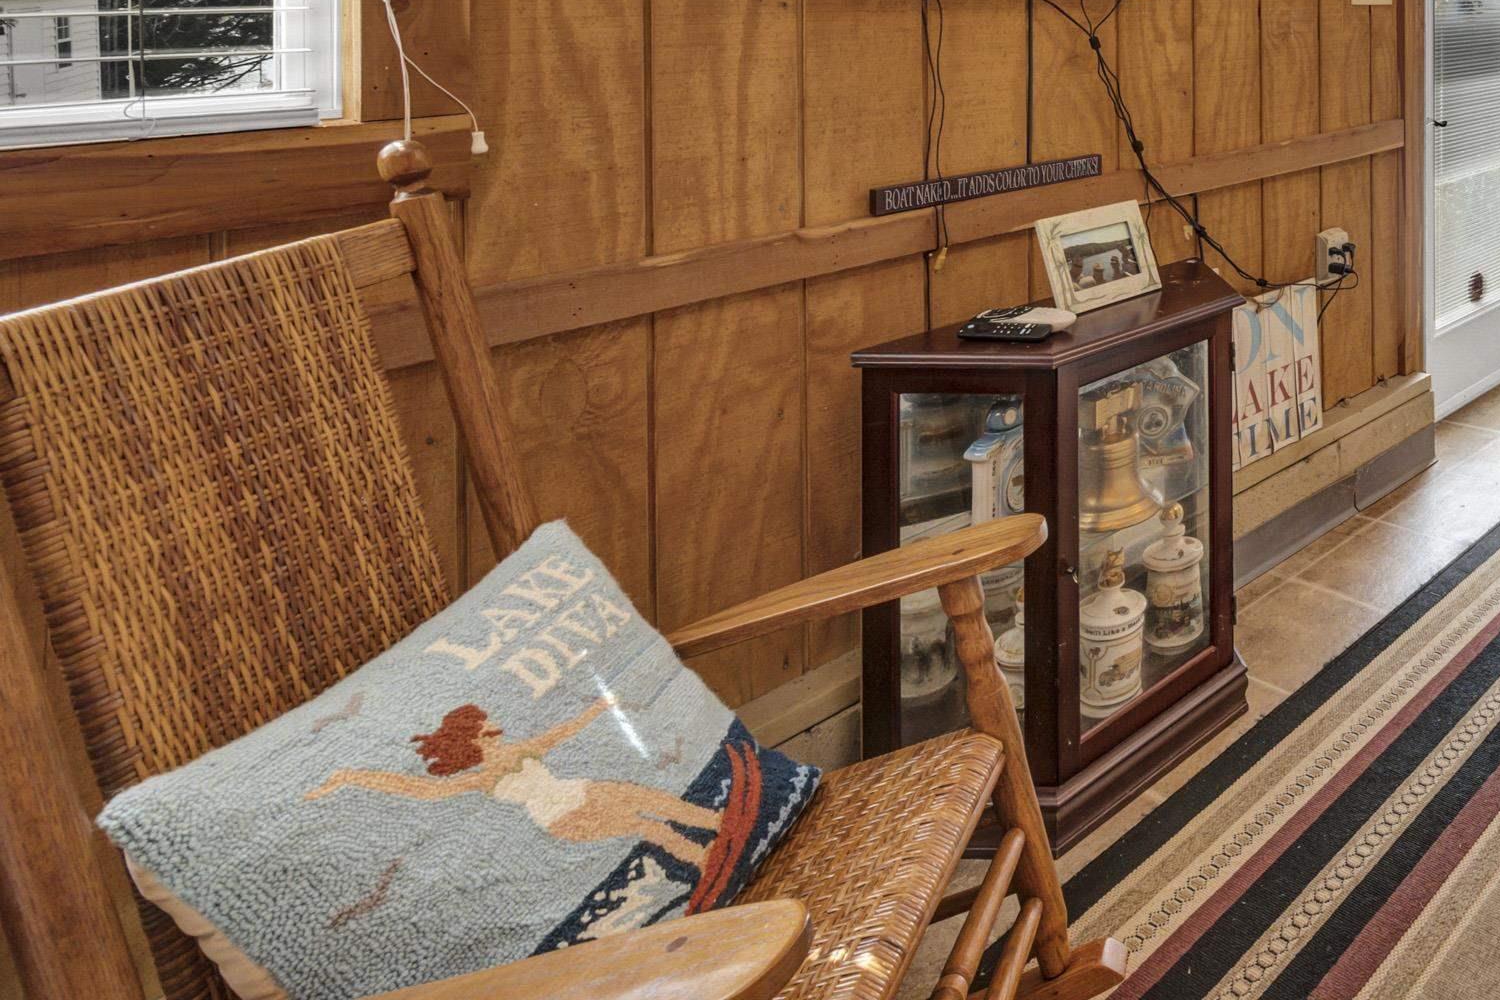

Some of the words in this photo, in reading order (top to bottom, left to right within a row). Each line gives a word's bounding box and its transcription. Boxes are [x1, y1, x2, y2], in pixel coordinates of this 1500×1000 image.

[884, 186, 914, 211] BOAT
[968, 173, 995, 196] ADDS
[996, 168, 1026, 191] COLOR
[1027, 166, 1040, 186] TO
[1041, 162, 1065, 184] YOUR
[1232, 354, 1315, 424] AKE
[425, 555, 594, 671] LAKE
[500, 593, 631, 699] DIVA
